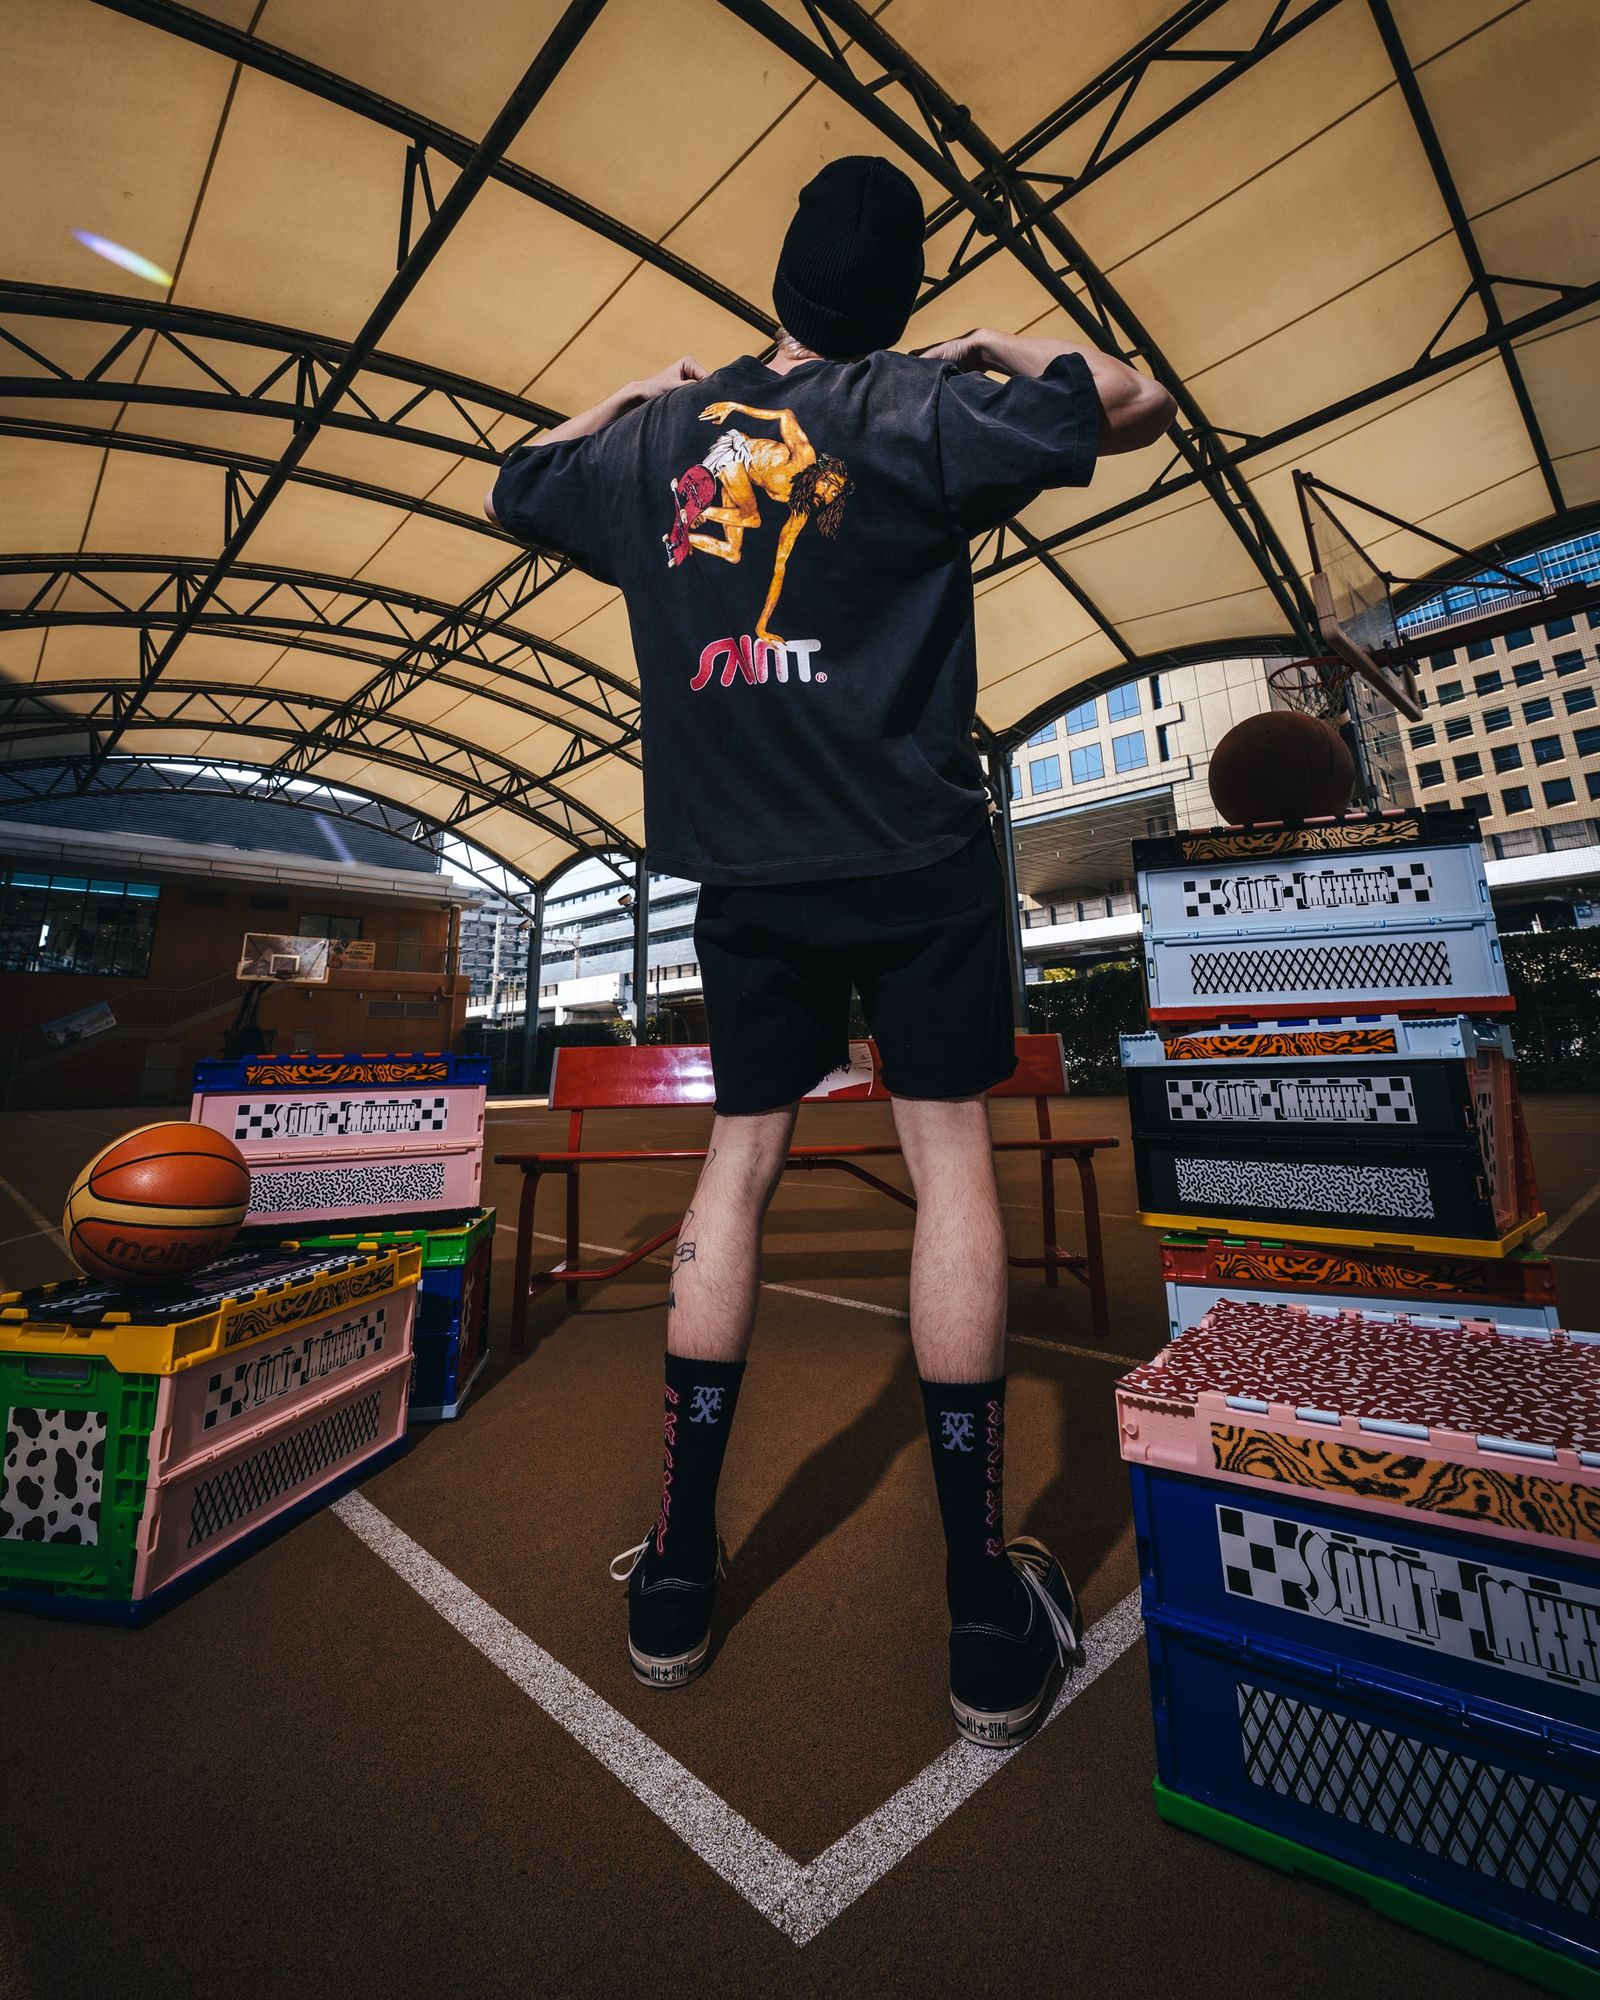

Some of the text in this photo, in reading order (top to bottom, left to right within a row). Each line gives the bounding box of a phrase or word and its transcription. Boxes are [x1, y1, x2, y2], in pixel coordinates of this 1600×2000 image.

[1221, 877, 1284, 914] SAINT
[1203, 1081, 1263, 1118] SAINT
[271, 1105, 331, 1137] SAINT
[240, 1351, 294, 1410] SAINT
[1299, 1529, 1441, 1640] SAINT
[650, 1663, 690, 1681] ALL STAR
[966, 1717, 1009, 1739] ALL STAR
